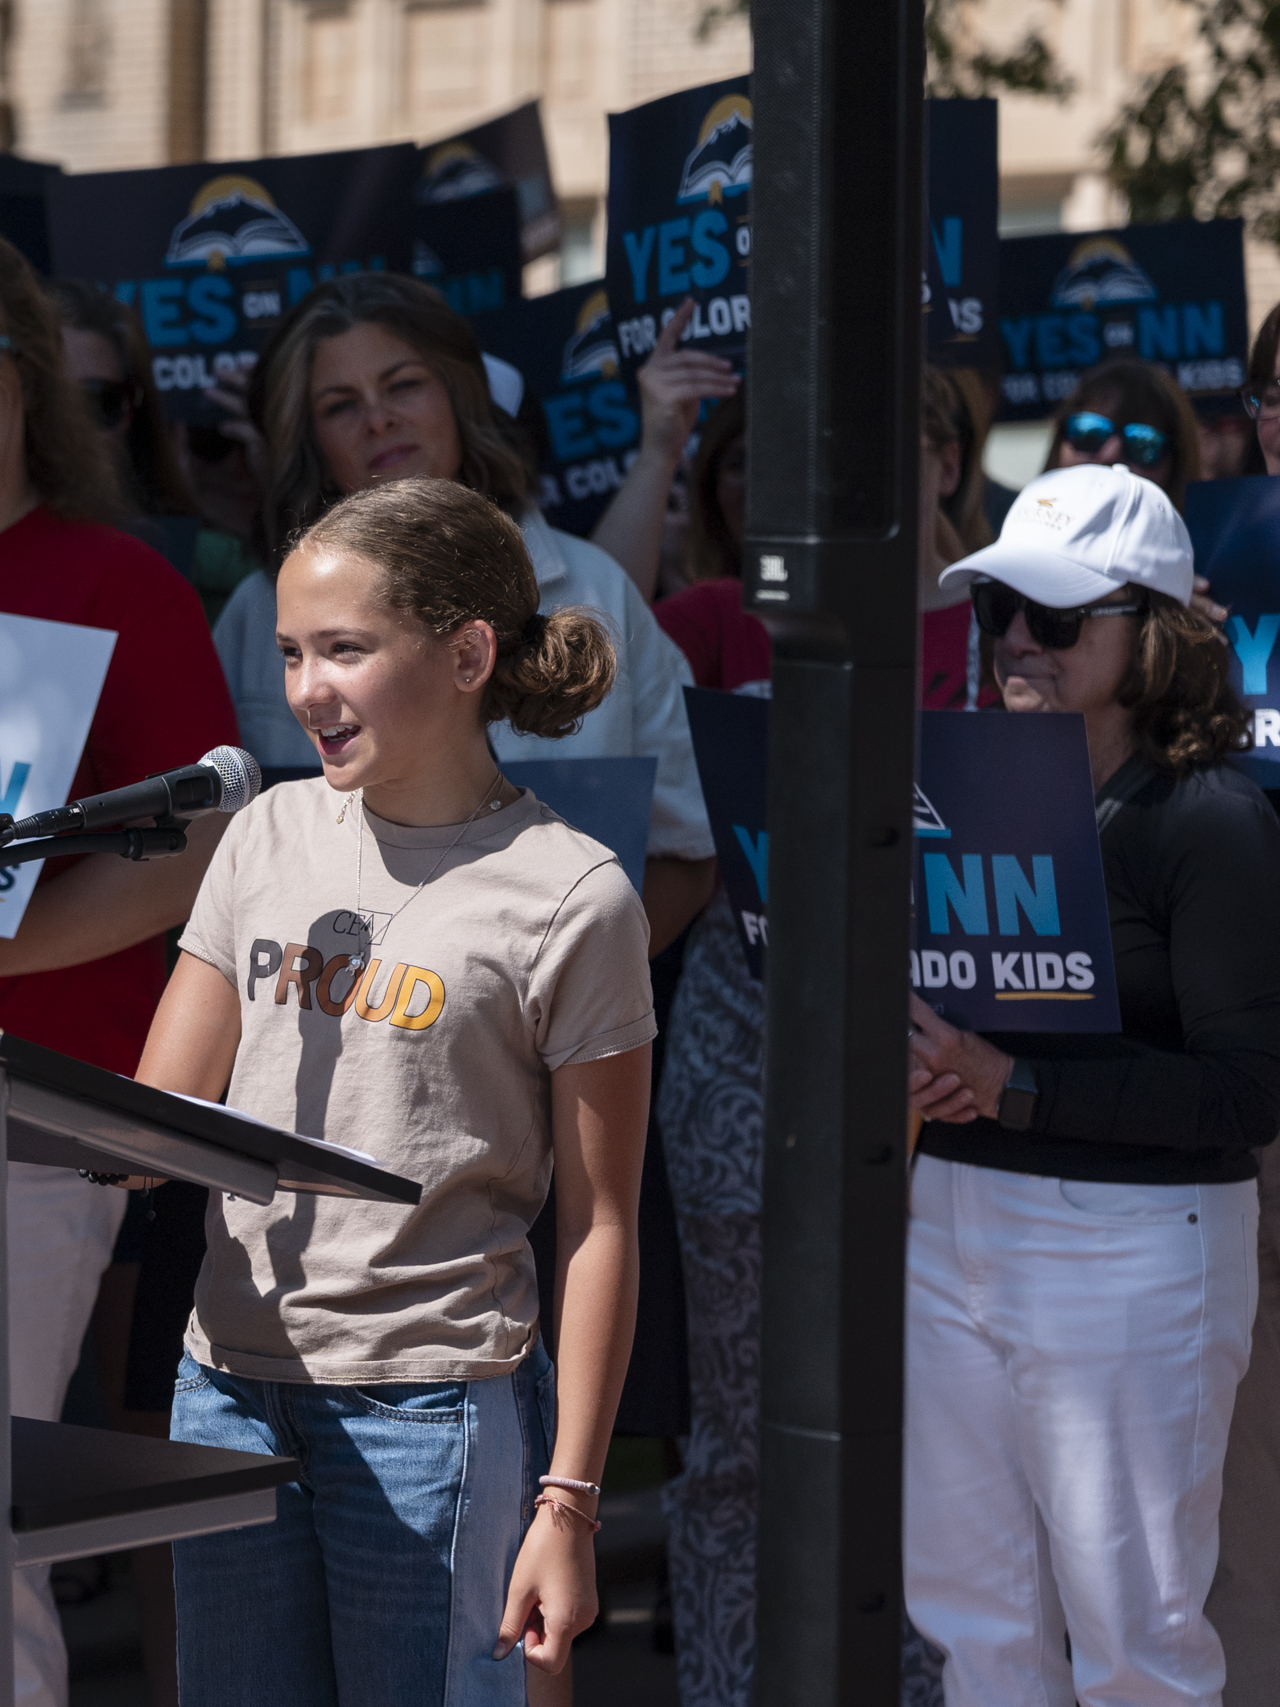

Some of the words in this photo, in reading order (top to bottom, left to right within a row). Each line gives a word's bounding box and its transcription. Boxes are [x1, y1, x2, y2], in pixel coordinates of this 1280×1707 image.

[621, 207, 732, 304] YES
[115, 272, 239, 347] ES
[241, 290, 282, 319] ON
[999, 312, 1102, 370] YES
[1135, 299, 1227, 360] NN
[543, 380, 641, 462] ES
[923, 851, 1062, 937] NN
[247, 938, 446, 1031] PROUD
[992, 951, 1096, 990] KIDS
